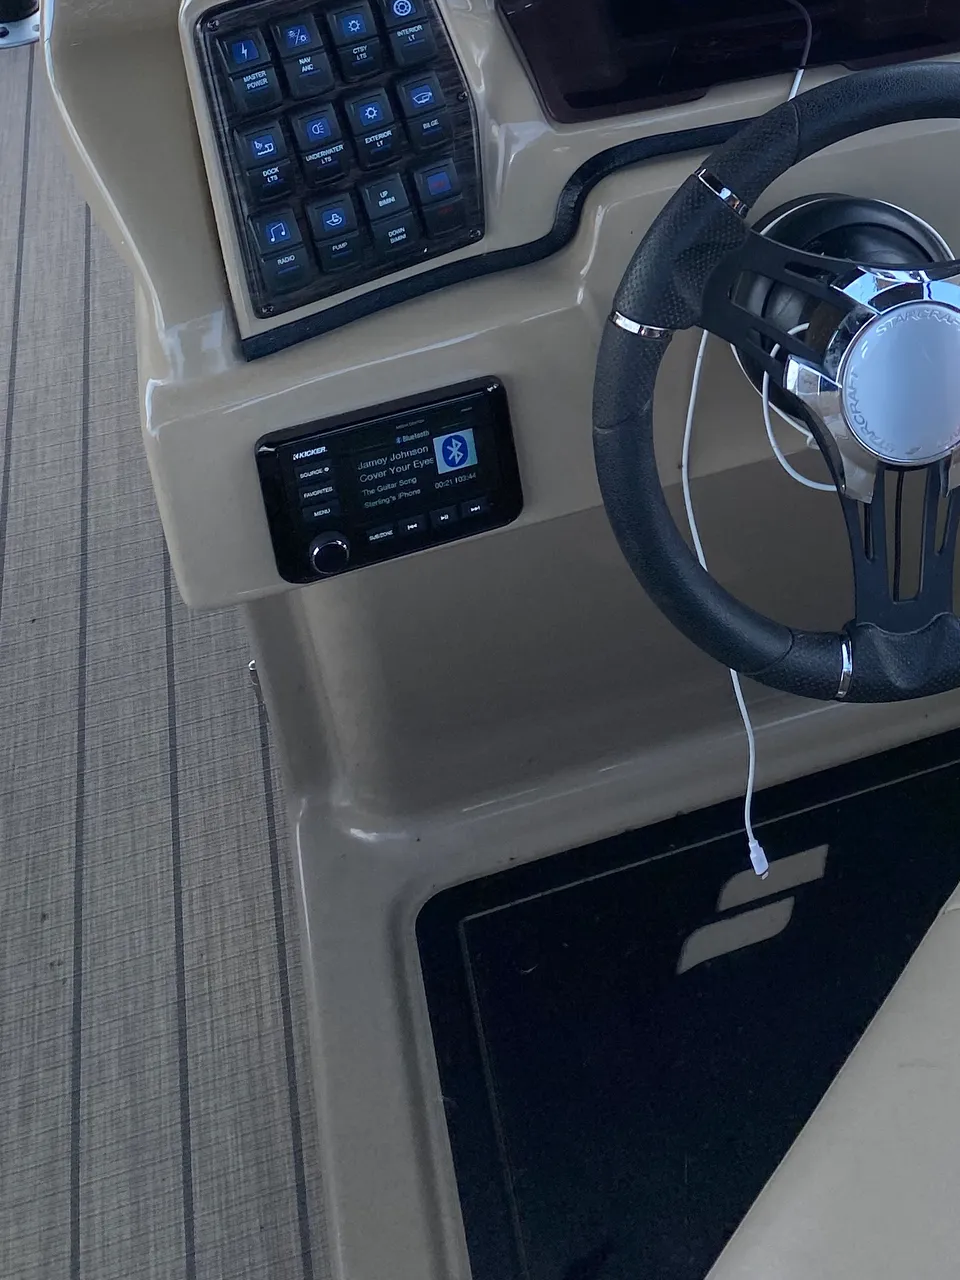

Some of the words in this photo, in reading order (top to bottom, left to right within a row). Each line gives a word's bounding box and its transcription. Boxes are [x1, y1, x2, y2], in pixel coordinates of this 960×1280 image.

[396, 24, 423, 37] INTERIOR
[299, 56, 311, 65] NAV
[301, 63, 314, 73] ANC
[243, 70, 267, 83] MASTER
[246, 78, 269, 90] POWER
[422, 119, 439, 130] BILGE
[365, 130, 392, 144] EXTERIOR
[305, 144, 344, 162] UNDERWATER
[262, 166, 280, 177] DOCK
[380, 190, 388, 198] UP
[388, 227, 405, 238] DOWN
[332, 241, 348, 251] PUMP
[277, 254, 296, 266] RADIO
[402, 430, 430, 442] Bluetooth
[299, 446, 326, 459] KICKER
[390, 445, 429, 462] Johnson
[300, 468, 323, 479] SOURCE
[359, 470, 387, 483] Cover
[389, 463, 411, 476] Your
[413, 456, 435, 470] Eyes
[303, 486, 333, 498] FAVORITES
[361, 488, 375, 497] The
[376, 482, 398, 494] Guitar
[399, 476, 418, 488] Song
[313, 508, 331, 517] MENU
